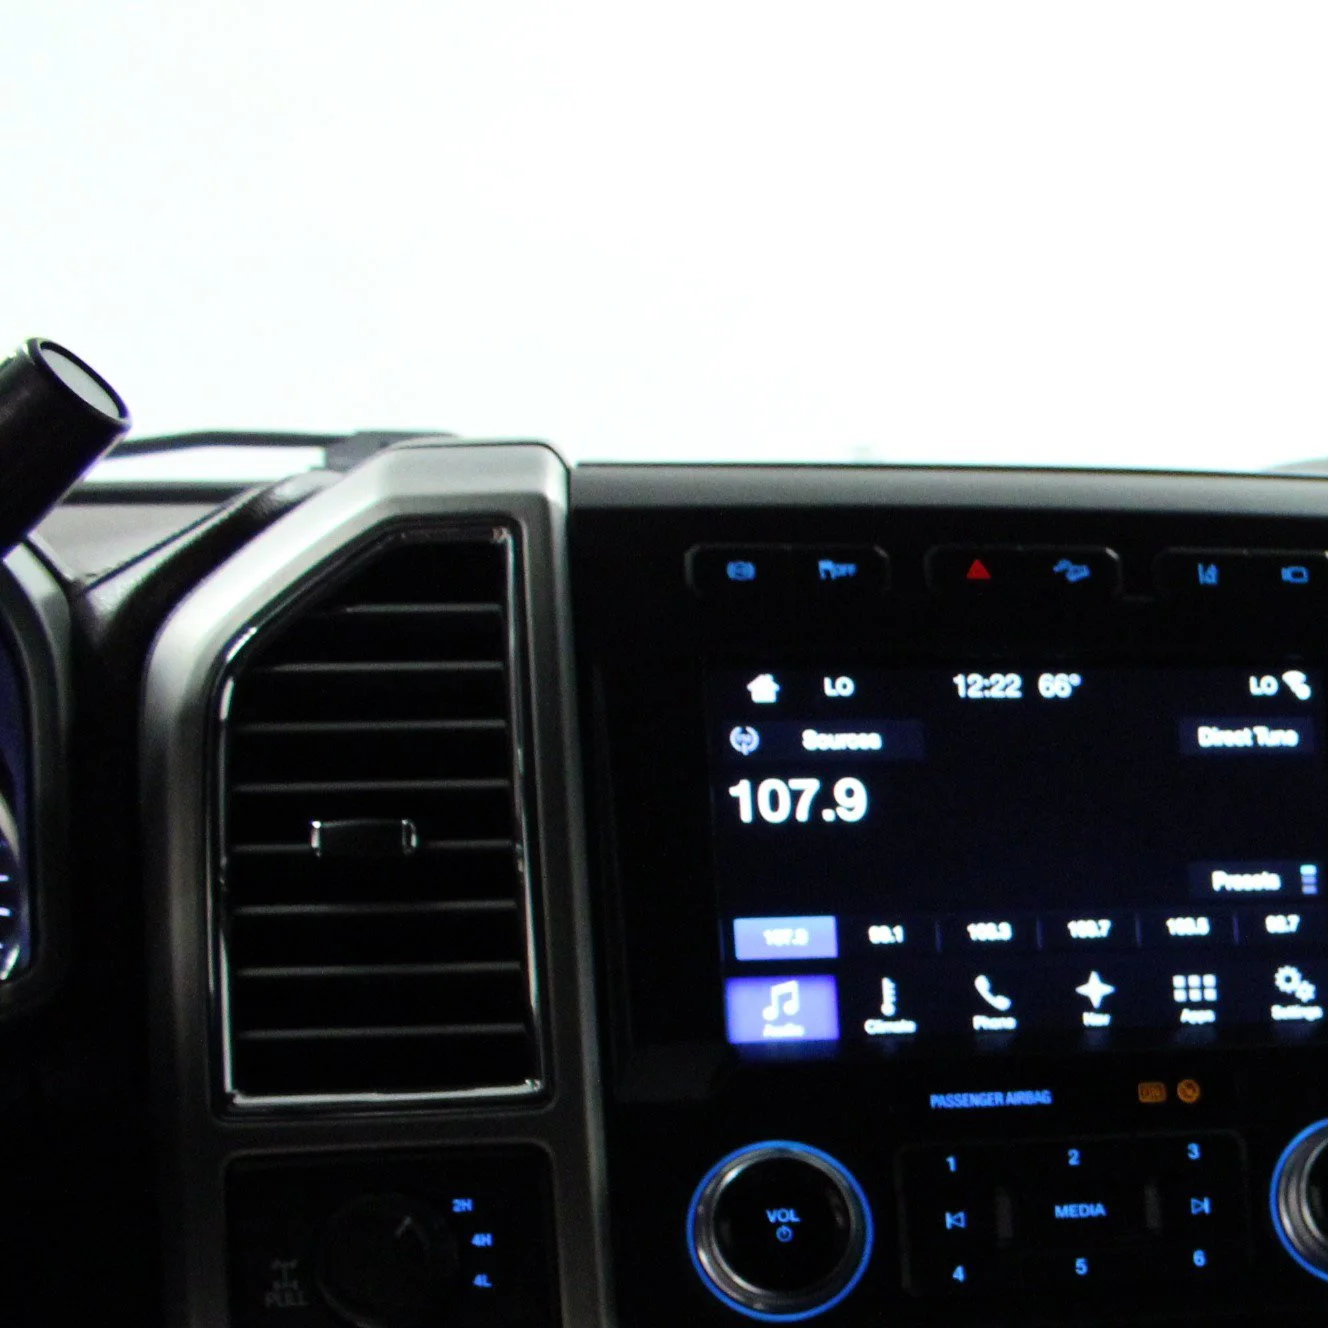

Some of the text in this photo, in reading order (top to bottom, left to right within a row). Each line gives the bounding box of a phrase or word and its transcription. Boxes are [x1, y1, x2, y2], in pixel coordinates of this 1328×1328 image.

[824, 676, 855, 697] LO
[953, 673, 1082, 699] 12:22 66°
[1249, 675, 1279, 696] LO
[802, 729, 882, 750] Sources
[1198, 726, 1299, 747] Direct Tune
[729, 777, 868, 823] 107.9
[1212, 871, 1281, 891] Presets
[864, 1019, 917, 1034] Climate
[973, 1015, 1017, 1030] Phone
[930, 1090, 1053, 1108] PASSENGER AIRBAG
[1068, 1149, 1080, 1166] 2
[1188, 1143, 1201, 1160] 3
[946, 1156, 957, 1172] 1
[452, 1199, 473, 1212] 2H
[1055, 1203, 1107, 1218] MEDIA
[766, 1207, 801, 1223] VOL
[471, 1233, 493, 1247] 4H
[1076, 1258, 1088, 1275] 5
[1193, 1250, 1206, 1267] 6
[473, 1274, 492, 1287] 4L
[953, 1266, 966, 1282] 4
